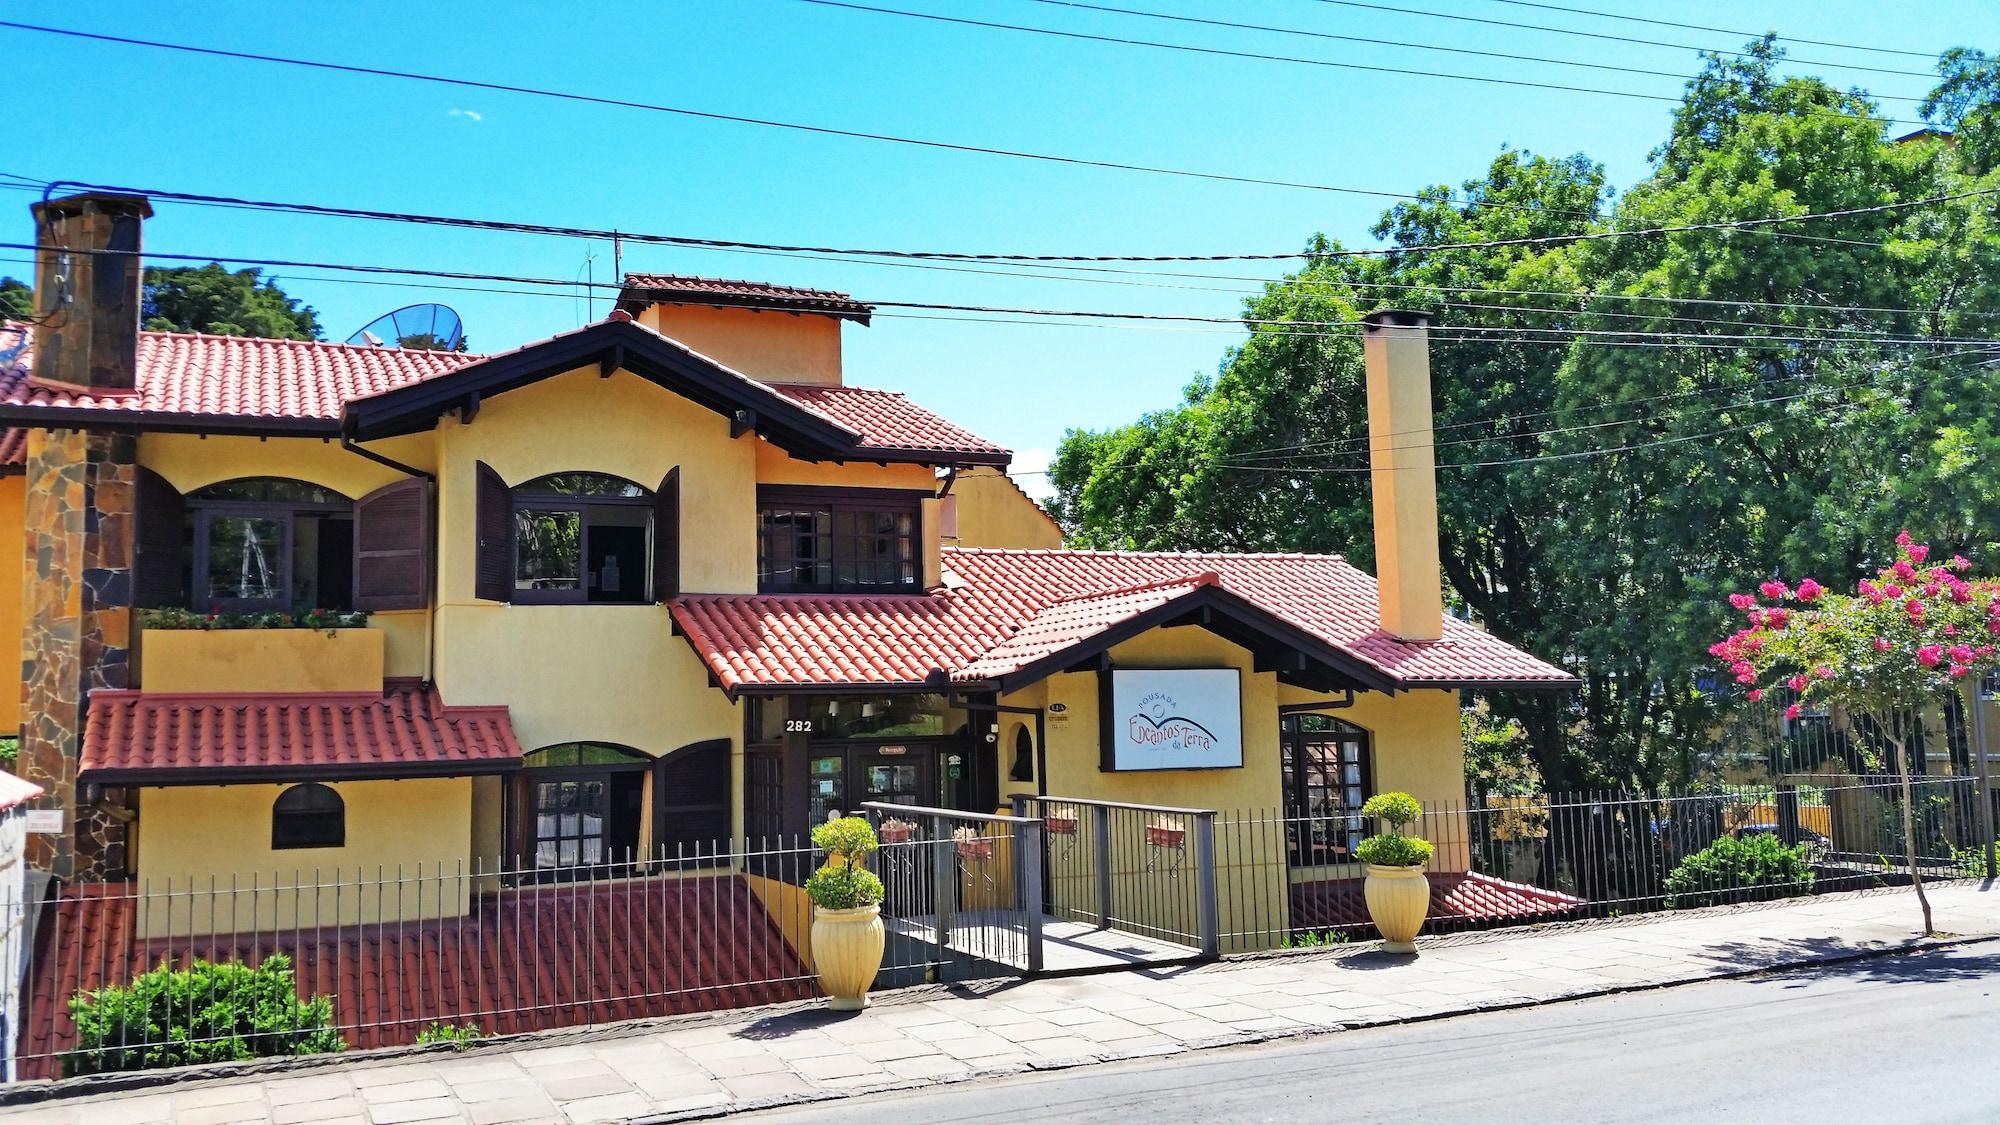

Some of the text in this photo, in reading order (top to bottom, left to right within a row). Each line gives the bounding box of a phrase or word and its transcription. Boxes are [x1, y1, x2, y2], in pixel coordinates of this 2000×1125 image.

[1138, 692, 1177, 709] POUSADA
[786, 720, 812, 732] 282
[1129, 714, 1180, 746] Encantos
[1181, 727, 1210, 751] Terra
